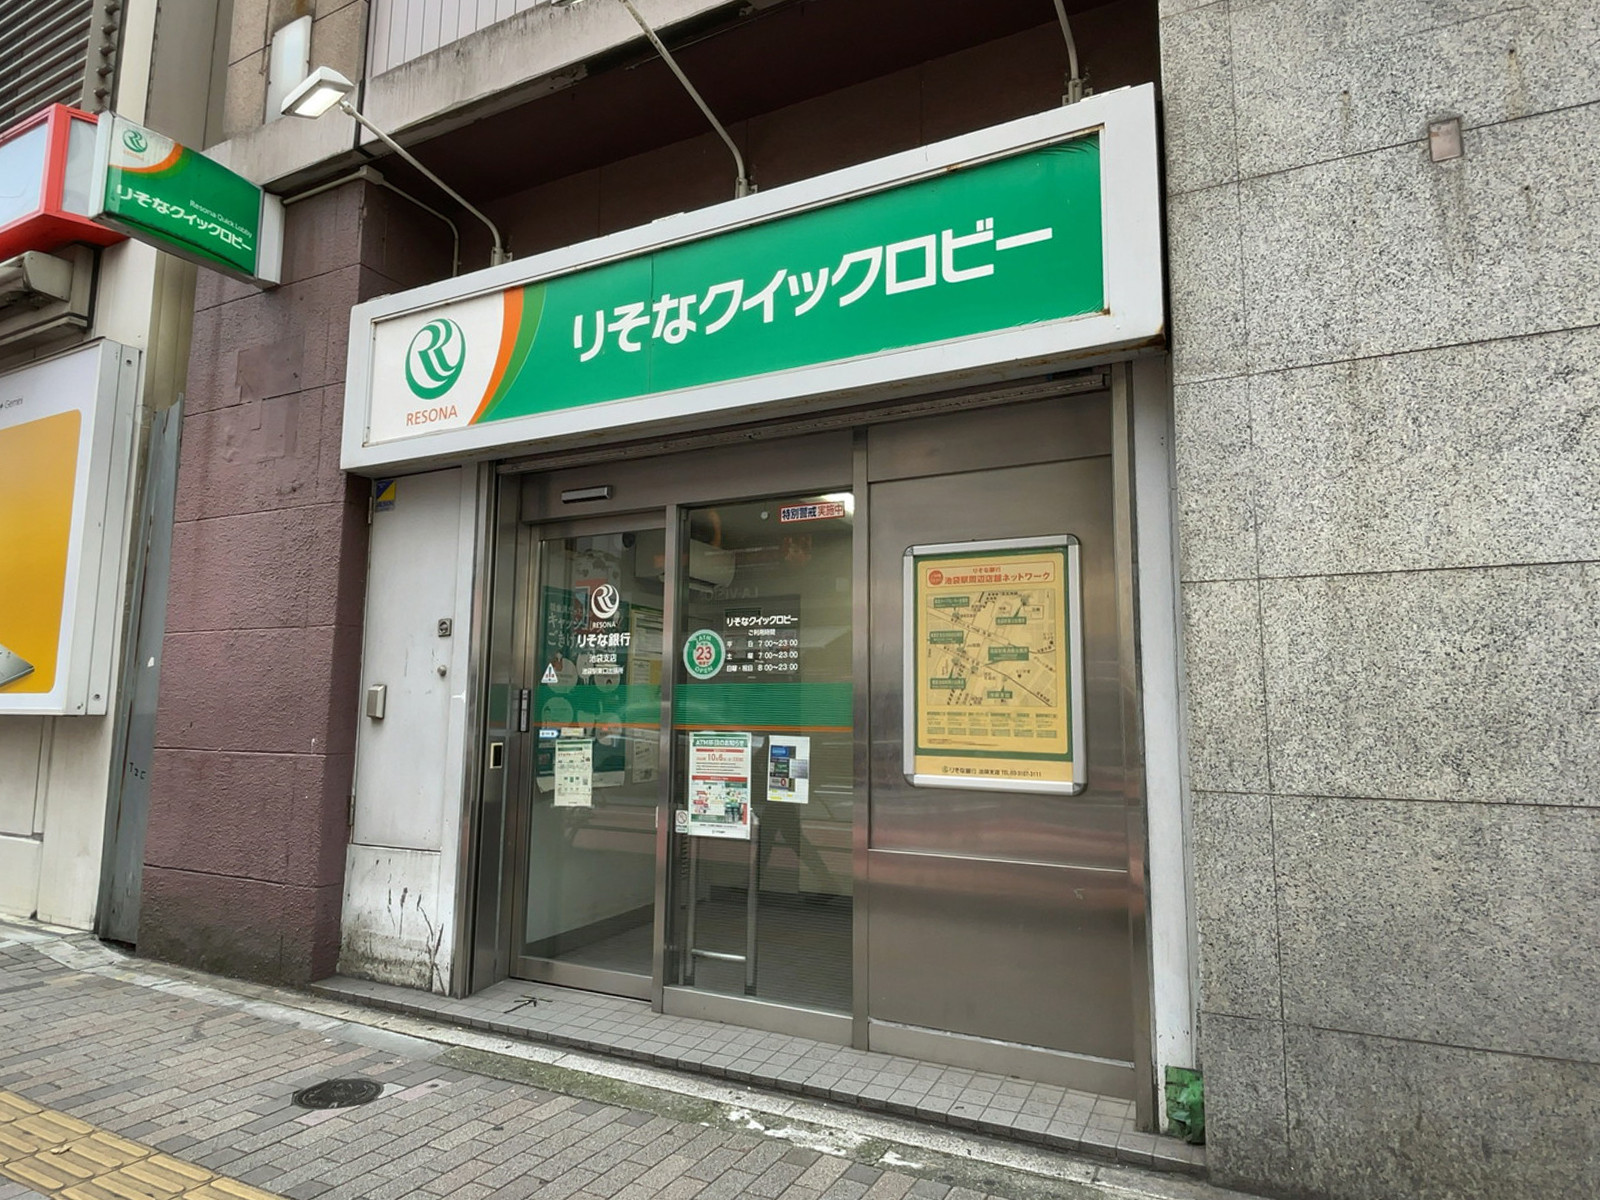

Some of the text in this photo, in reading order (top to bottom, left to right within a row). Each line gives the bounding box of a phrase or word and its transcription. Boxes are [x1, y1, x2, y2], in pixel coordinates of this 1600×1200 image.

[116, 184, 253, 251] りそなクイックロビー
[190, 200, 217, 218] Resona
[217, 213, 234, 227] Quick
[573, 217, 1053, 362] りそなクイックロビー
[406, 405, 458, 426] RESONA
[726, 614, 799, 627] りそなクイックロビー
[577, 632, 631, 648] りそな銀行
[758, 639, 798, 648] 700～2300
[696, 646, 712, 661] 23
[758, 651, 798, 660] 700～2300
[757, 663, 798, 672] 800～2300
